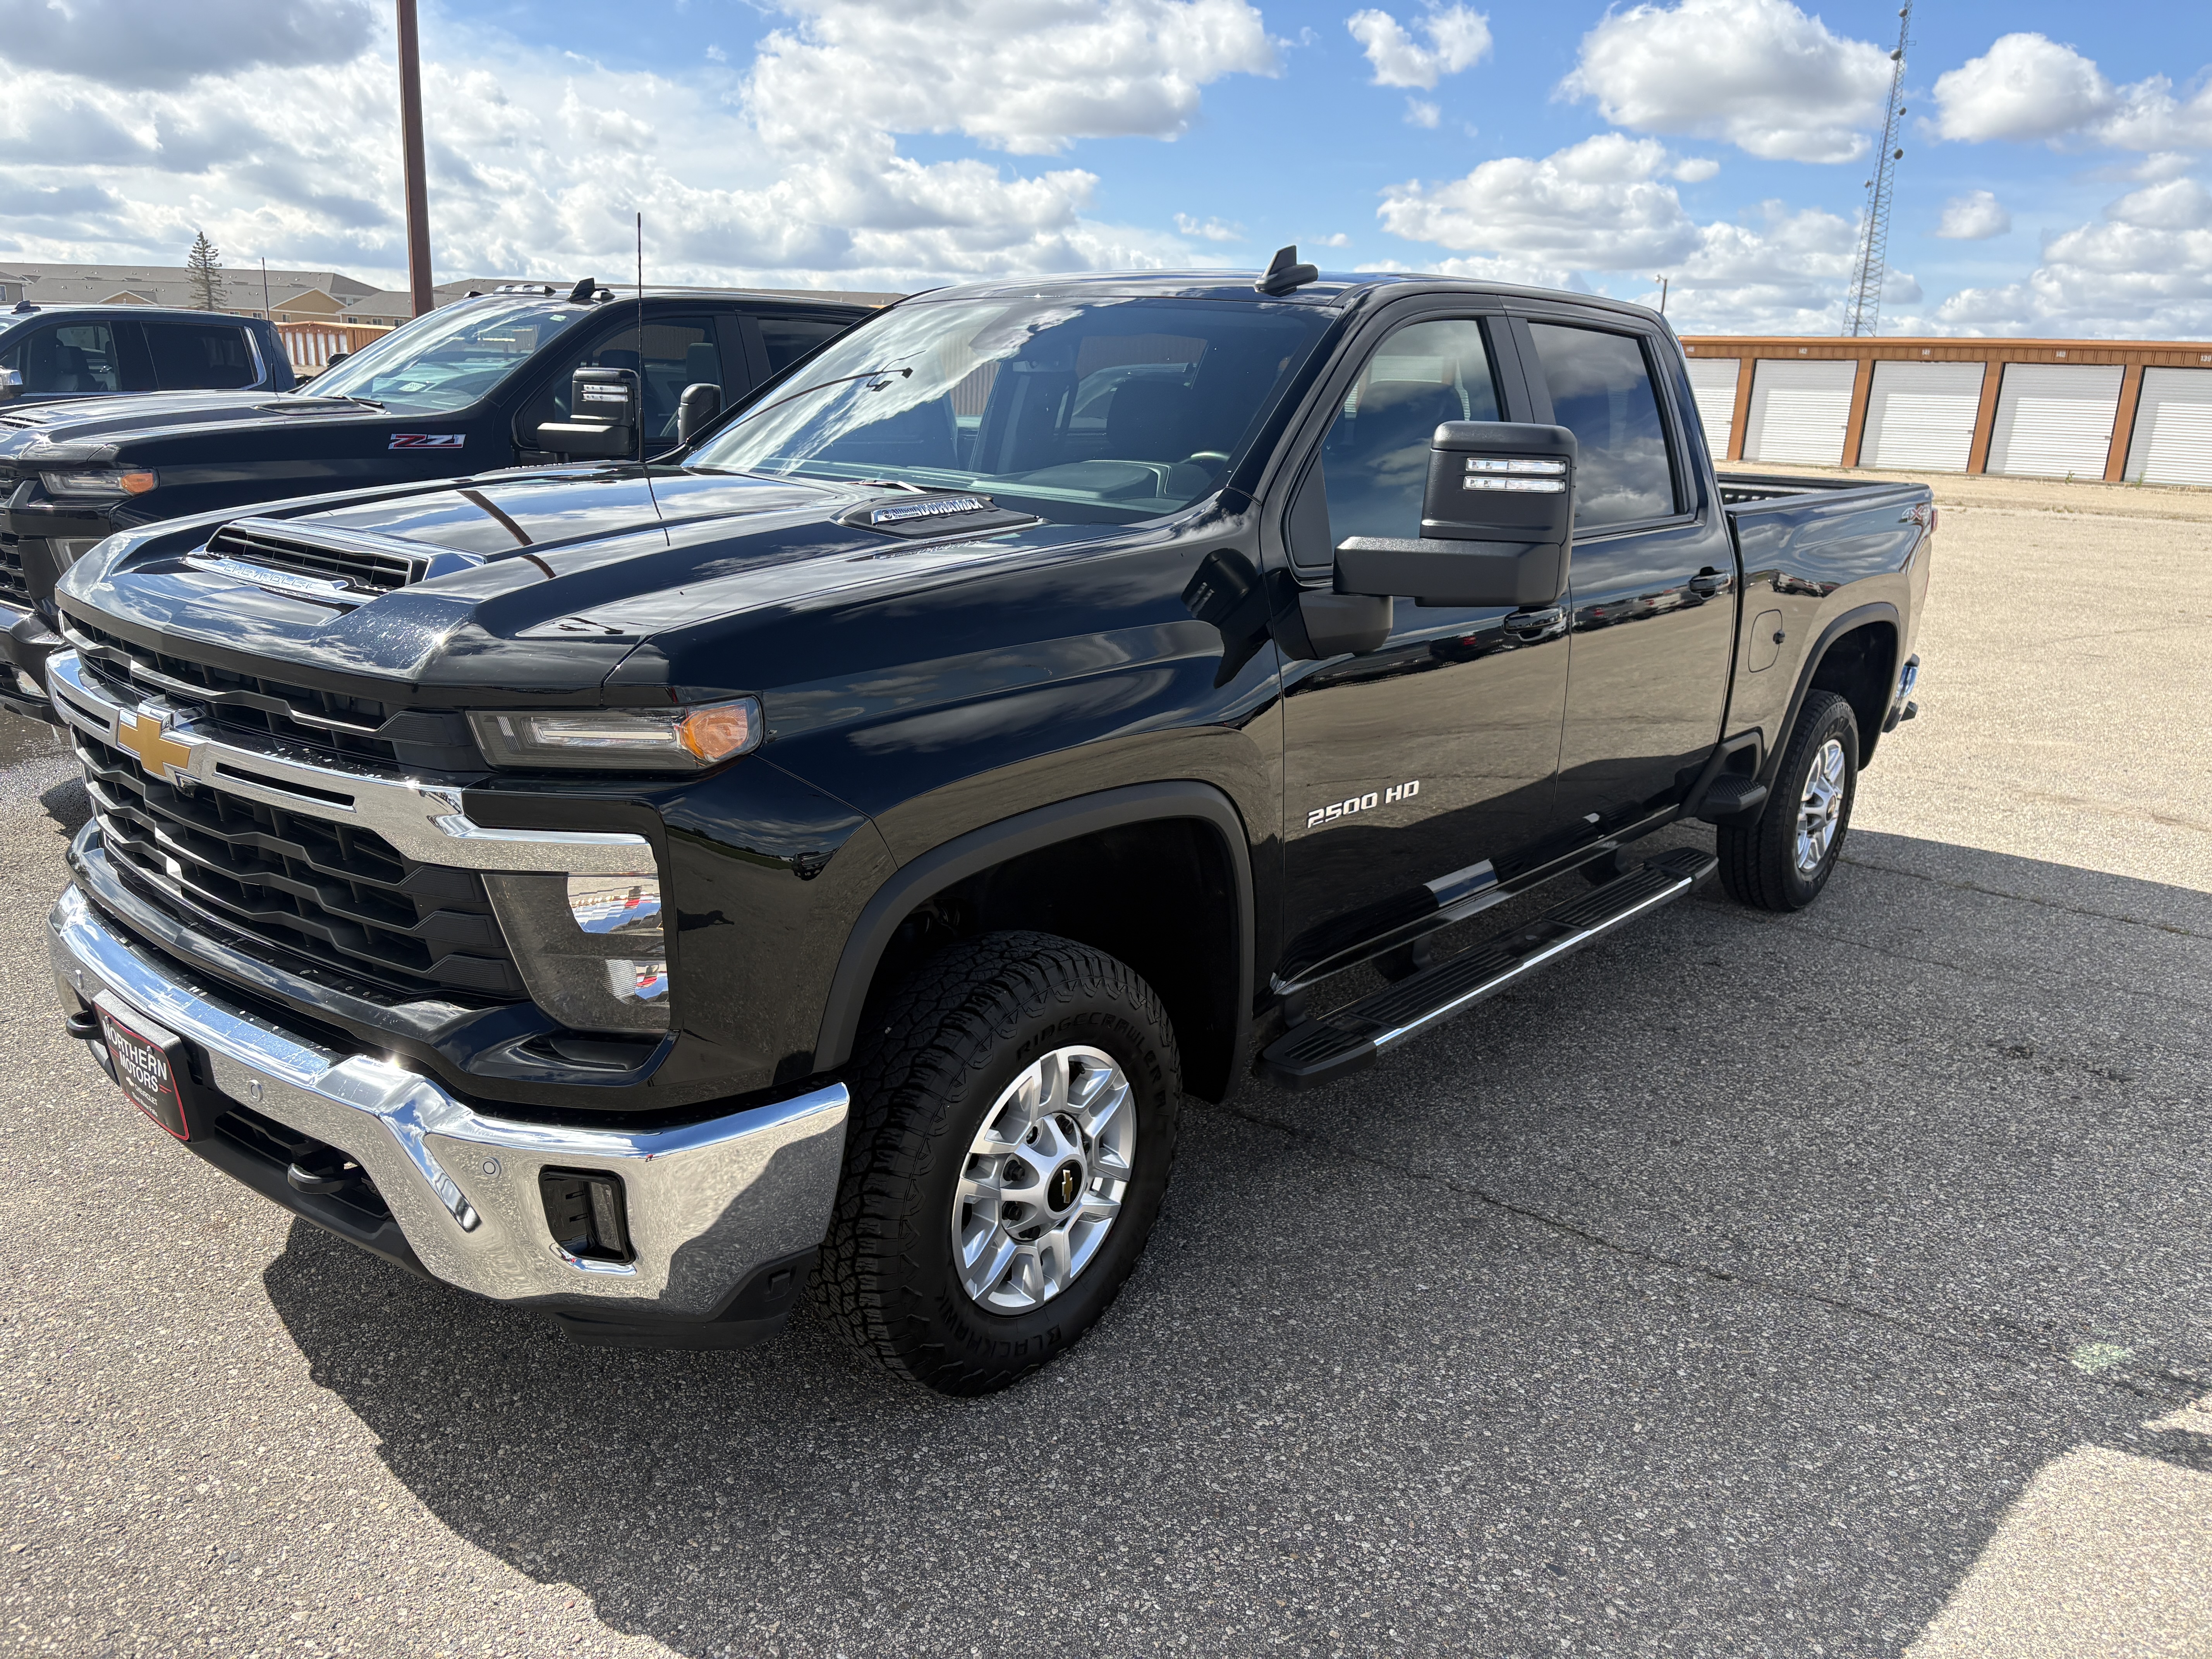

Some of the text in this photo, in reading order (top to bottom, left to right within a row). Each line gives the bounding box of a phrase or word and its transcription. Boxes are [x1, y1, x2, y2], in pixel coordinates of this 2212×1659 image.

[388, 433, 466, 450] Z71
[916, 498, 983, 516] DURAMAX
[224, 563, 317, 589] CHEVROLET
[1306, 780, 1419, 829] 2500 HD
[102, 1020, 167, 1080] NORTHERN
[119, 1051, 158, 1092] MOTORS
[934, 1283, 1063, 1358] BLACKHAWK
